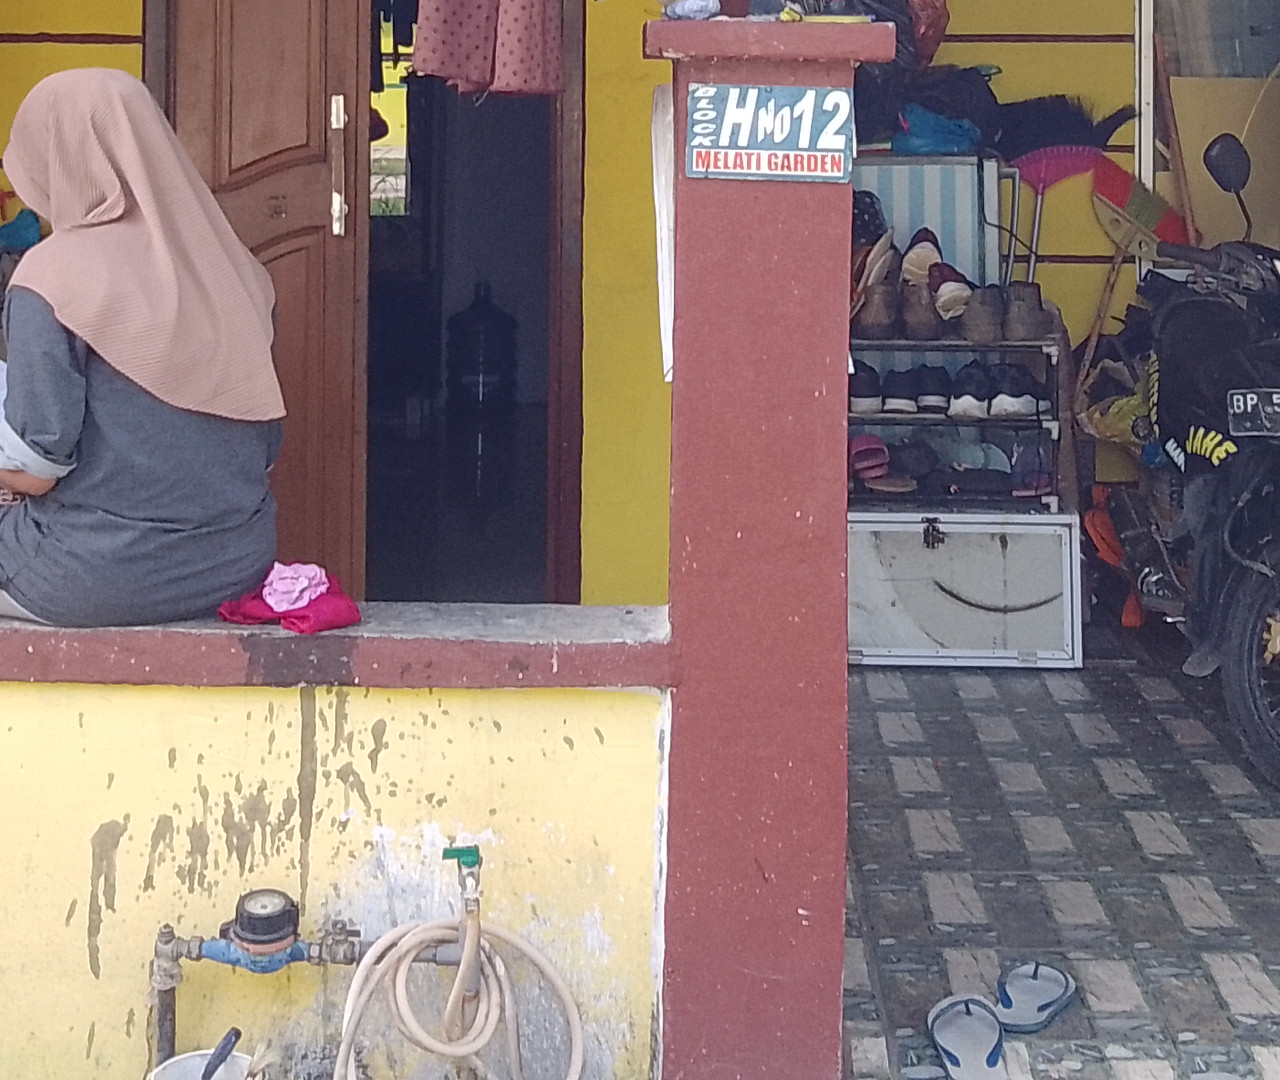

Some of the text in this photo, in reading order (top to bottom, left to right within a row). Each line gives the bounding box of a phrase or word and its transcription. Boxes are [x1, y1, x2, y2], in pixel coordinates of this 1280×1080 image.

[690, 87, 718, 147] BLOCK
[695, 150, 842, 173] MELATI GARDEN
[1232, 393, 1258, 413] BP
[1185, 425, 1238, 467] JAHE
